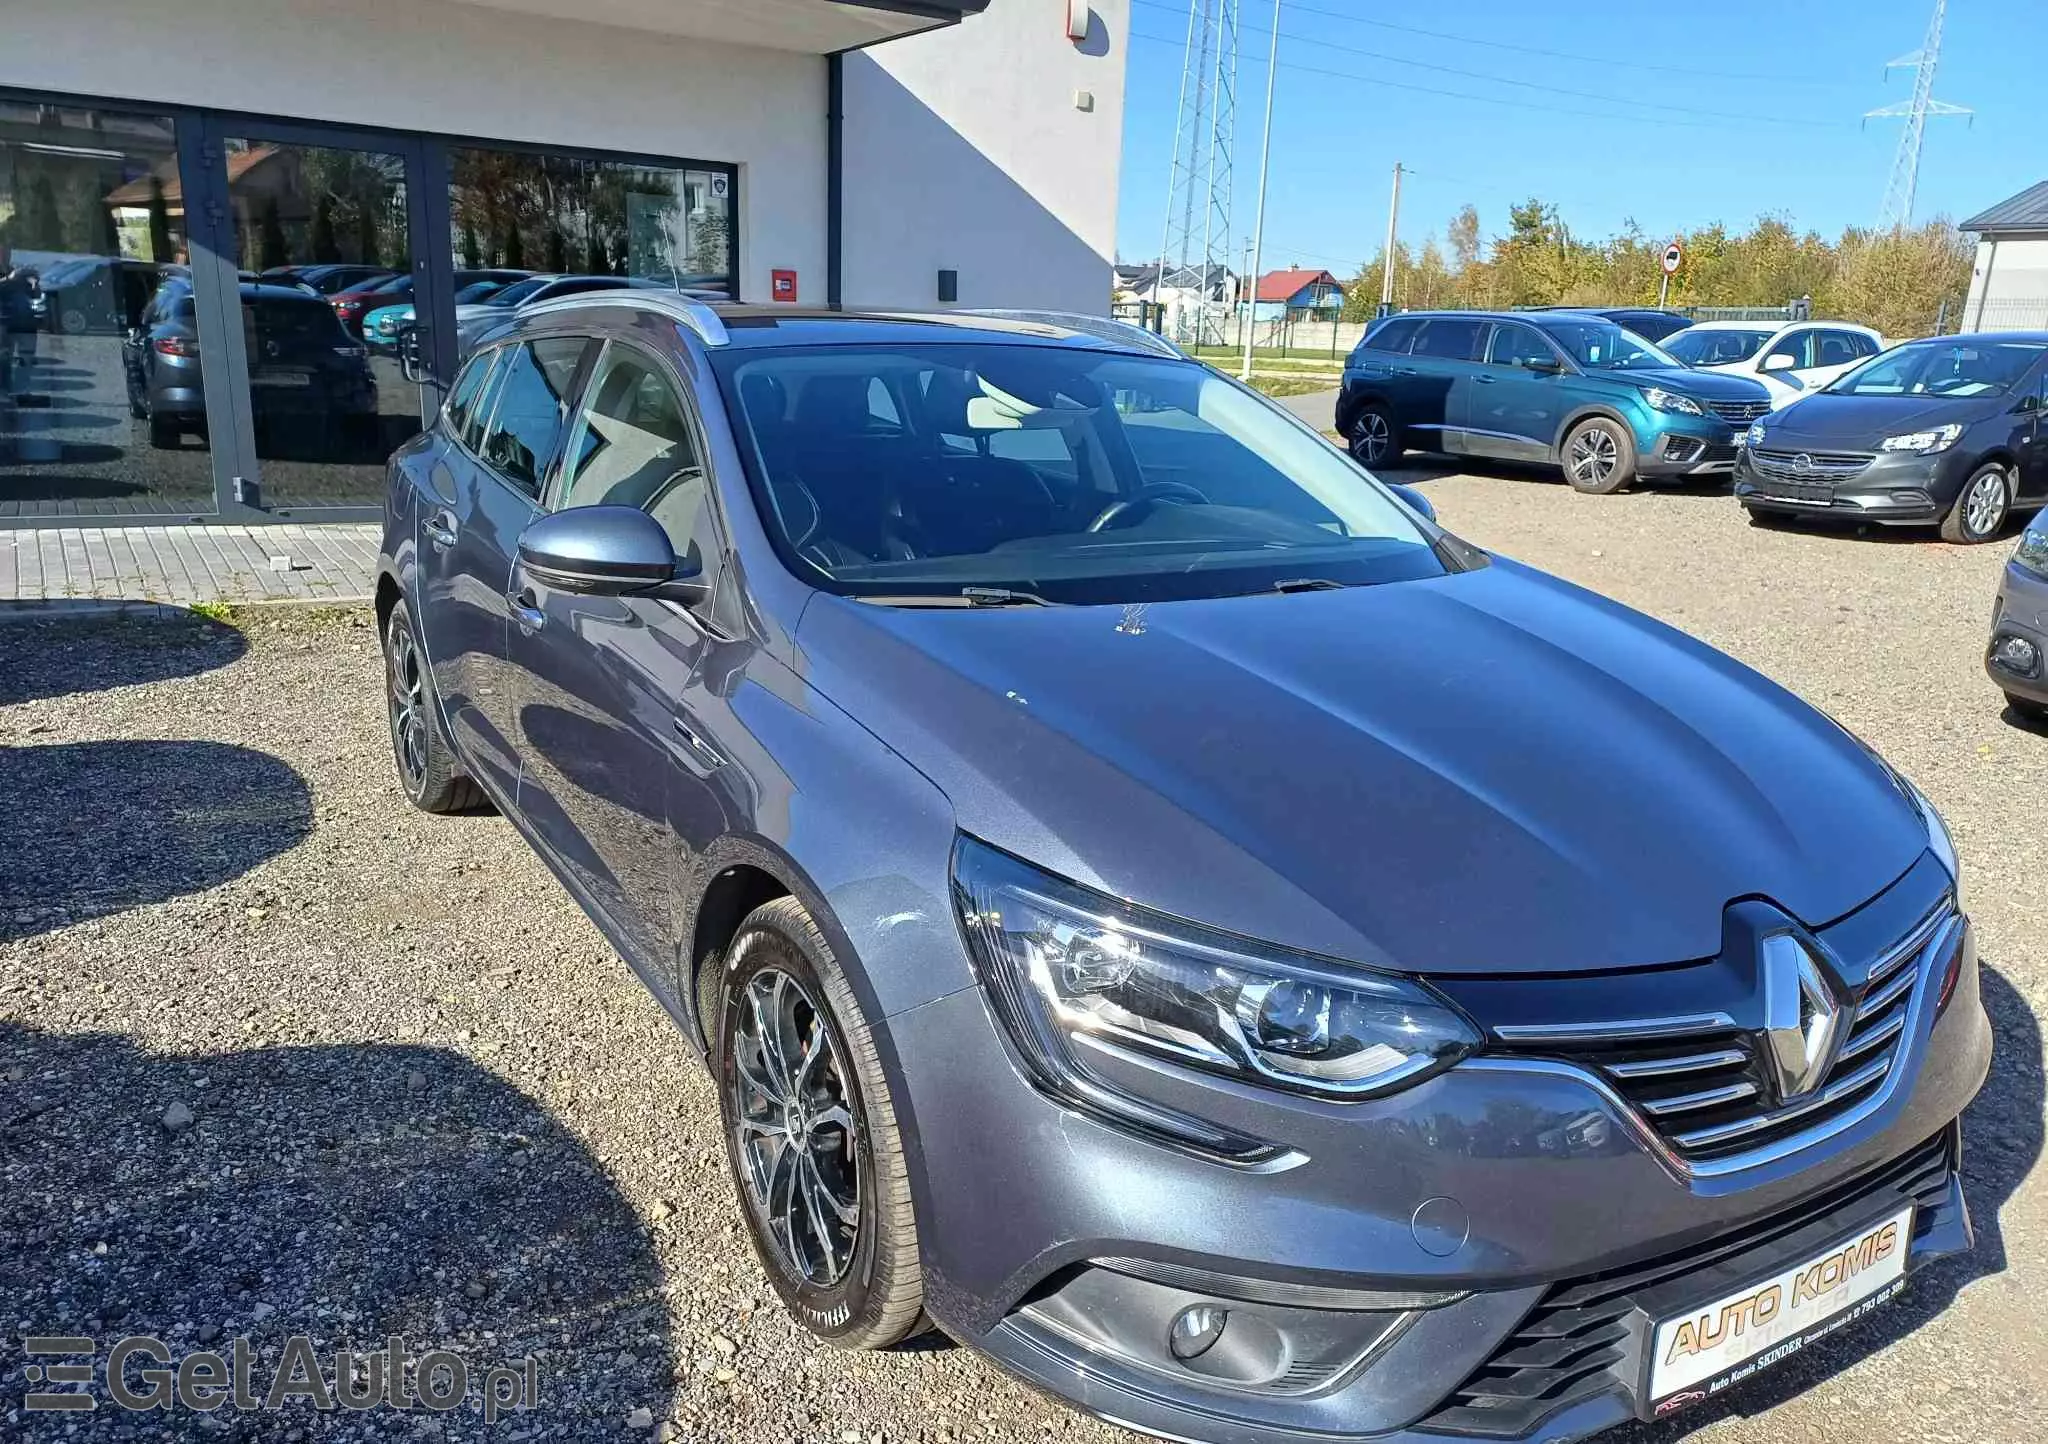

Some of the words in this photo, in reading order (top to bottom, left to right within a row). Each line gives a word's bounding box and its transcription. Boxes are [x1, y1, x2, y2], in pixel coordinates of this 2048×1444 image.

[1664, 1284, 1781, 1366] AUTO
[1791, 1221, 1898, 1308] KOMIS
[1709, 1378, 1729, 1394] Auto
[1730, 1363, 1756, 1383] Komis
[1757, 1337, 1802, 1370] SKINDER
